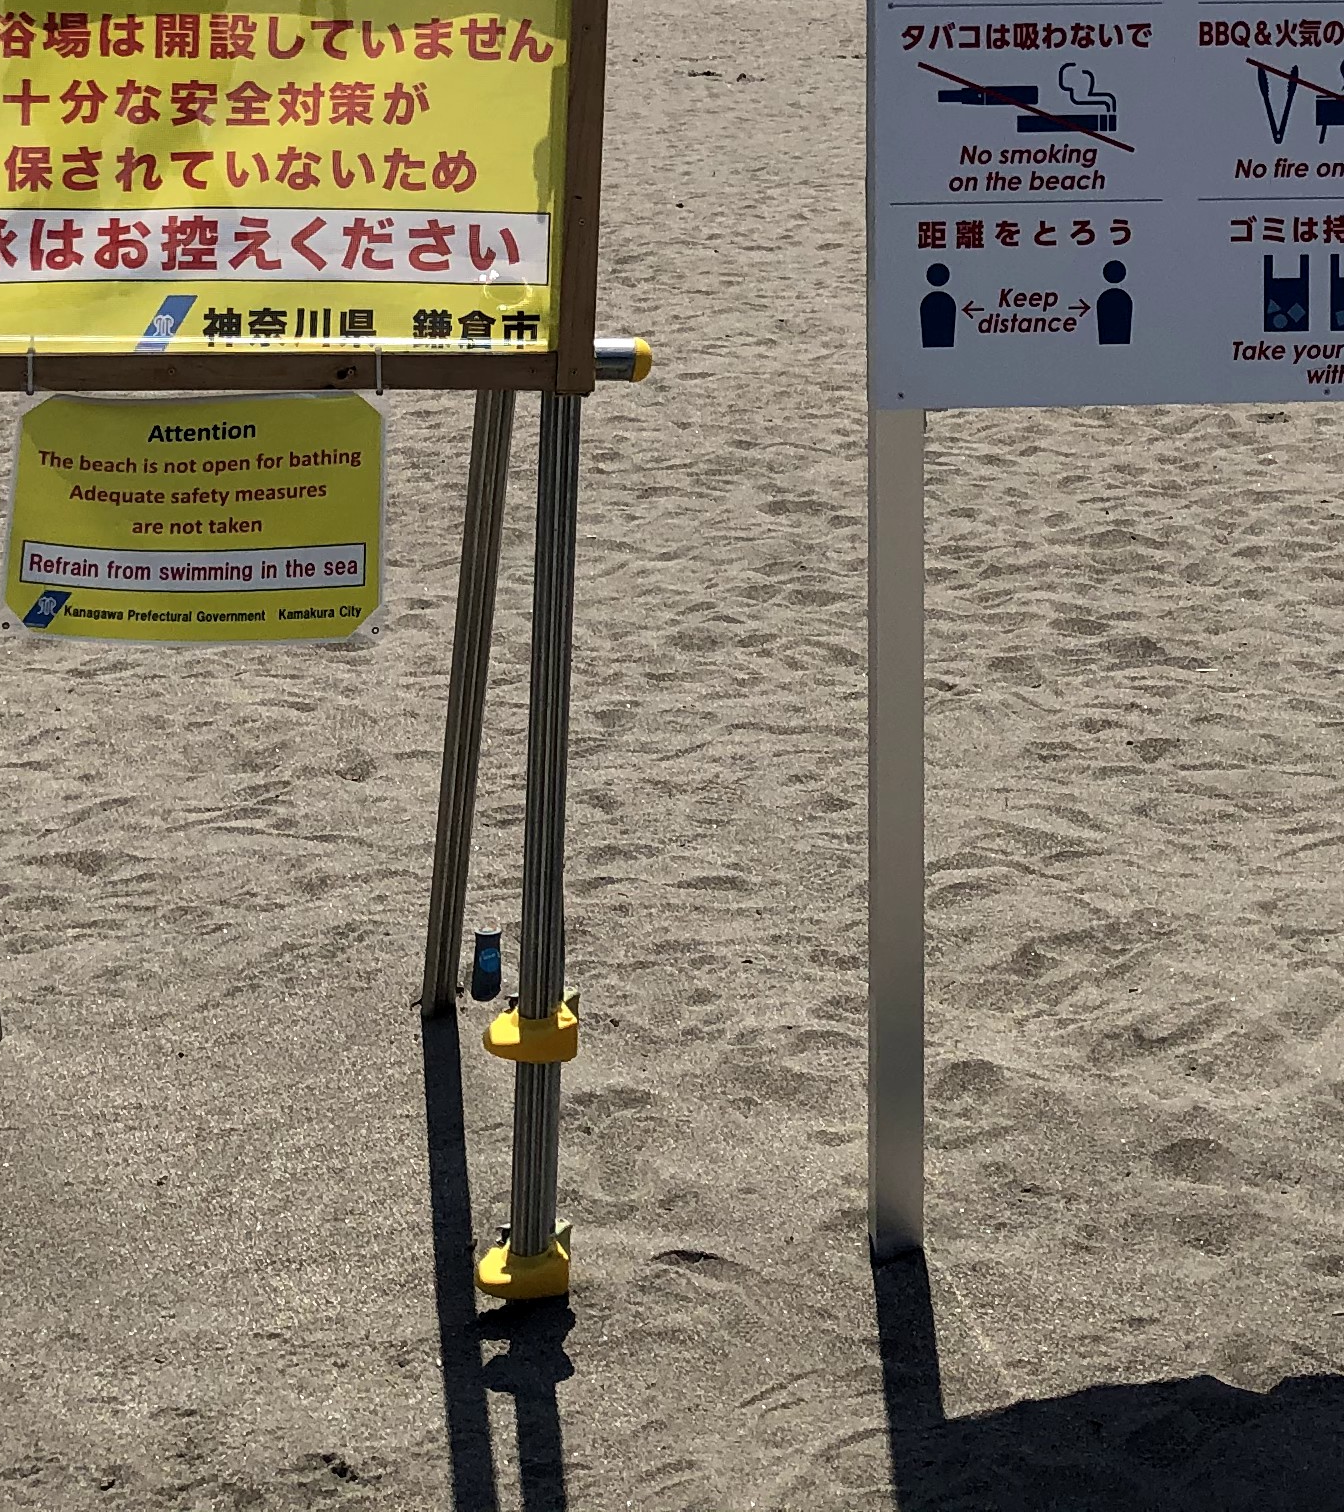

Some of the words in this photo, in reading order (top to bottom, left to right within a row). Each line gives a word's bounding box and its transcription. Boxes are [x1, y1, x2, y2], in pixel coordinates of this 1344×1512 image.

[900, 20, 1153, 51] タバコは吸わないで
[2, 80, 431, 128] 十分な安全対策が
[959, 145, 993, 166] No
[998, 143, 1099, 169] smoking
[948, 173, 982, 192] on
[985, 171, 1024, 192] the
[1028, 170, 1106, 192] beach
[1234, 159, 1268, 179] No
[1273, 159, 1309, 179] fire
[1316, 160, 1344, 179] on
[917, 218, 1133, 250] 距離をとろう
[998, 288, 1059, 311] Keep
[202, 307, 377, 348] 神奈川県
[412, 309, 541, 350] 鎌倉市
[977, 312, 1078, 335] distance
[1232, 340, 1287, 362] Take
[1292, 343, 1344, 366] your
[147, 421, 257, 444] Attention
[38, 450, 74, 471] The
[79, 455, 137, 474] beach
[143, 458, 158, 474] is
[163, 458, 196, 475] not
[202, 458, 251, 477] open
[256, 452, 284, 471] for
[288, 449, 362, 469] bathing
[68, 484, 166, 507] Adequate
[170, 486, 230, 507] safety
[235, 483, 328, 503] measures
[131, 520, 164, 535] are
[169, 519, 203, 535] not
[208, 517, 263, 535] taken
[28, 552, 100, 579] Refrain
[107, 560, 152, 581] from
[159, 562, 253, 582] swimming
[260, 559, 278, 580] in
[285, 558, 316, 578] the
[323, 559, 359, 576] sea
[63, 604, 124, 622] Kanagawa
[127, 607, 193, 622] Prefectural
[196, 609, 266, 623] Government
[278, 606, 335, 621] Kamakura
[339, 604, 362, 622] City
